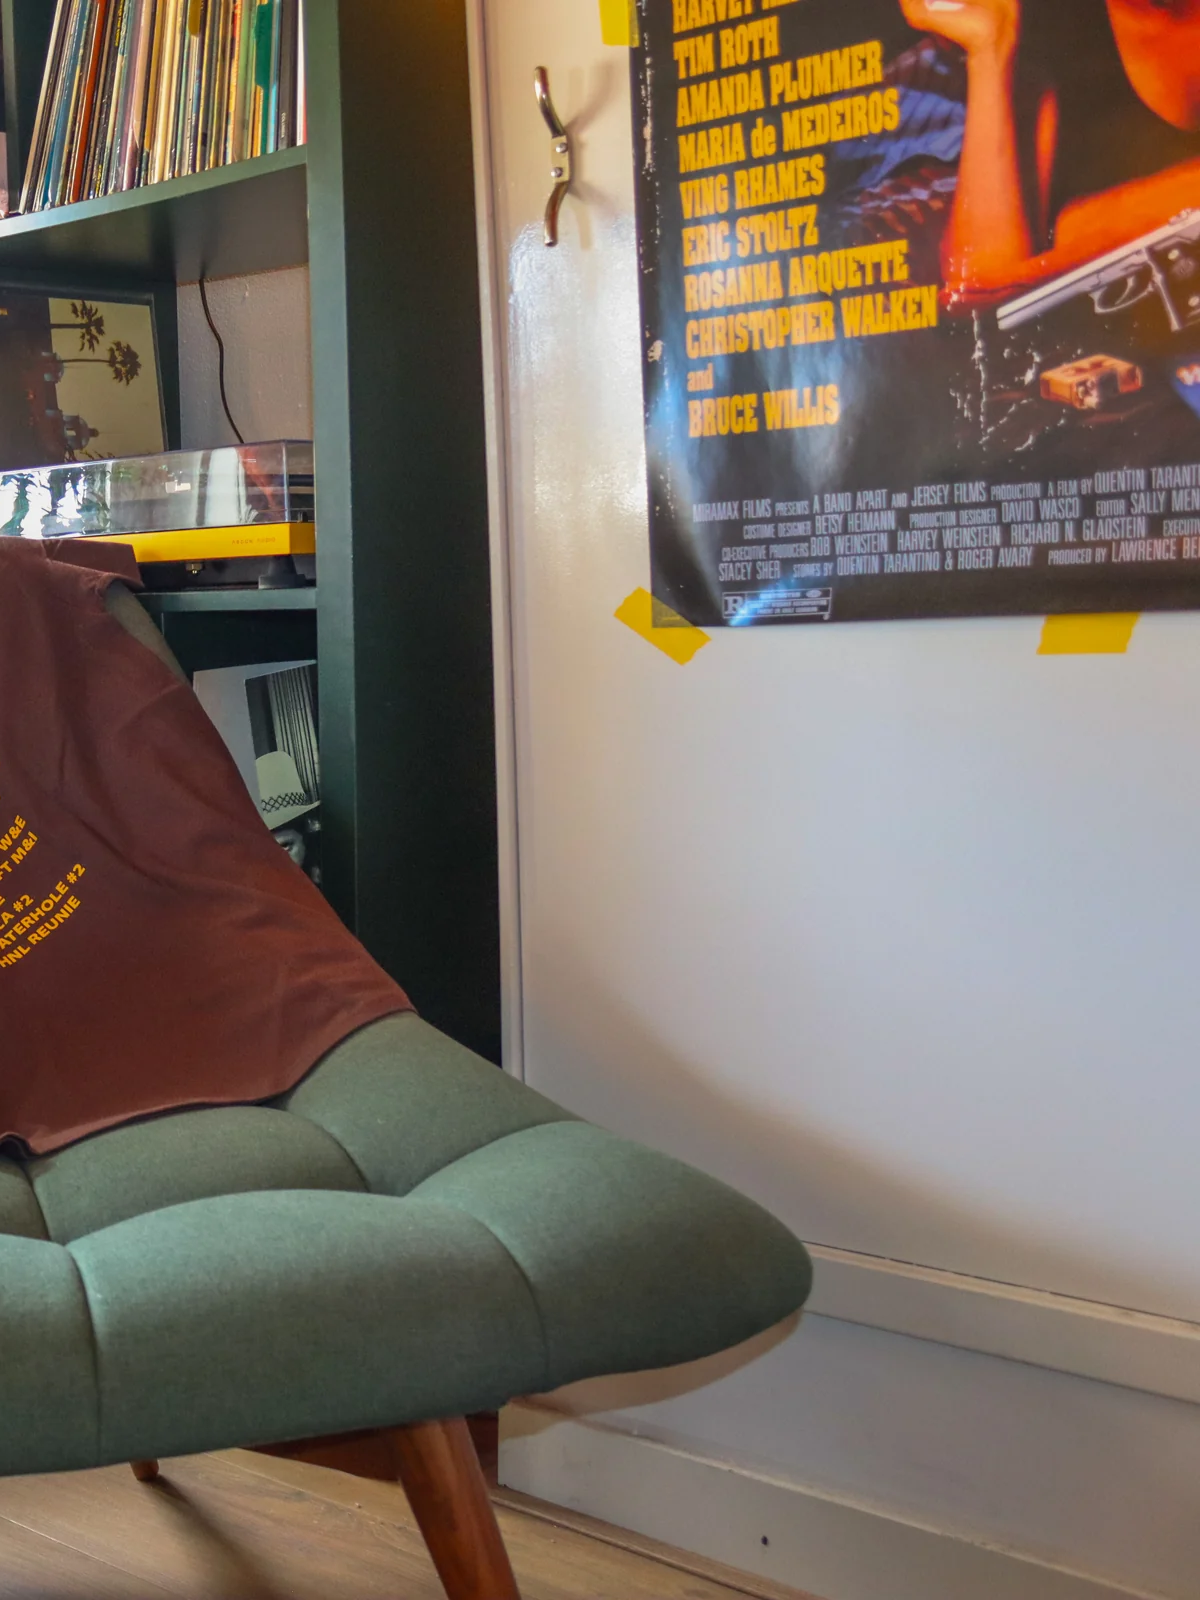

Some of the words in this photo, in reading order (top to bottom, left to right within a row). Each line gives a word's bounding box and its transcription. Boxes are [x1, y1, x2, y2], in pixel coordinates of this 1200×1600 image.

[673, 34, 714, 80] TIM
[720, 16, 779, 69] ROTH
[676, 69, 765, 128] AMANDA
[769, 40, 883, 106] PLUMMER
[678, 122, 746, 174] MARIA
[751, 117, 776, 158] de
[781, 87, 900, 152] MEDEIROS
[679, 173, 728, 219] VING
[734, 154, 825, 209] RHAMES
[682, 221, 730, 267] ERIC
[736, 204, 818, 258] STOLTZ
[684, 260, 783, 312] ROSANNA
[789, 240, 908, 296] ARQUETTE
[686, 300, 835, 359] CHRISTOPHER
[841, 285, 938, 338] WALKEN
[687, 363, 713, 392] and
[688, 394, 758, 438] BRUCE
[763, 384, 840, 431] WILLIS
[693, 501, 739, 522] MIRAMAX
[742, 499, 771, 518] FILMS
[775, 501, 809, 516] PRESENTS
[813, 495, 820, 513] A
[824, 492, 850, 513] BAND
[856, 489, 887, 510] APART
[891, 493, 907, 508] AND
[911, 483, 949, 507] JERSEY
[954, 482, 986, 503] FILMS
[991, 483, 1040, 500] PRODUCTION
[1048, 482, 1053, 496] A
[1057, 481, 1077, 496] FILM
[1081, 479, 1092, 494] BY
[1095, 469, 1144, 494] QUENTIN
[743, 524, 775, 539] COSTUME
[778, 521, 811, 537] DESIGNER
[815, 514, 843, 535] BETSY
[848, 510, 896, 532] HEIMANN
[909, 511, 957, 529] PRODUCTION
[960, 508, 996, 525] DESIGNER
[1002, 500, 1033, 523] DAVID
[1039, 497, 1079, 519] WASCO
[1096, 500, 1124, 516] EDITOR
[1130, 492, 1165, 515] SALLY
[718, 562, 753, 581] STACEY
[755, 560, 780, 579] SHER
[823, 562, 833, 576] BY
[837, 556, 878, 575] QUENTIN
[884, 552, 939, 572] TARANTINO
[944, 551, 953, 569] &
[958, 549, 995, 569] ROGER
[997, 546, 1033, 567] AVARY
[1048, 549, 1091, 565] PRODUCED
[1095, 548, 1107, 562] BY
[1112, 538, 1176, 562] LAWRENCE
[722, 545, 766, 561] CO-EXECUTIVE
[769, 543, 809, 559] PRODUCERS
[810, 536, 830, 556] BOB
[835, 532, 888, 554] WEINSTEIN
[897, 530, 937, 551] HARVEY
[943, 526, 1000, 549] WEINSTEIN
[1011, 522, 1059, 544] RICHARD
[1065, 521, 1076, 541] N.
[1082, 516, 1145, 541] GLADSTEIN
[724, 595, 743, 615] R
[10, 831, 38, 865] M&I
[66, 863, 86, 884] #2
[12, 894, 34, 913] #2
[27, 895, 81, 945] REUNIE
